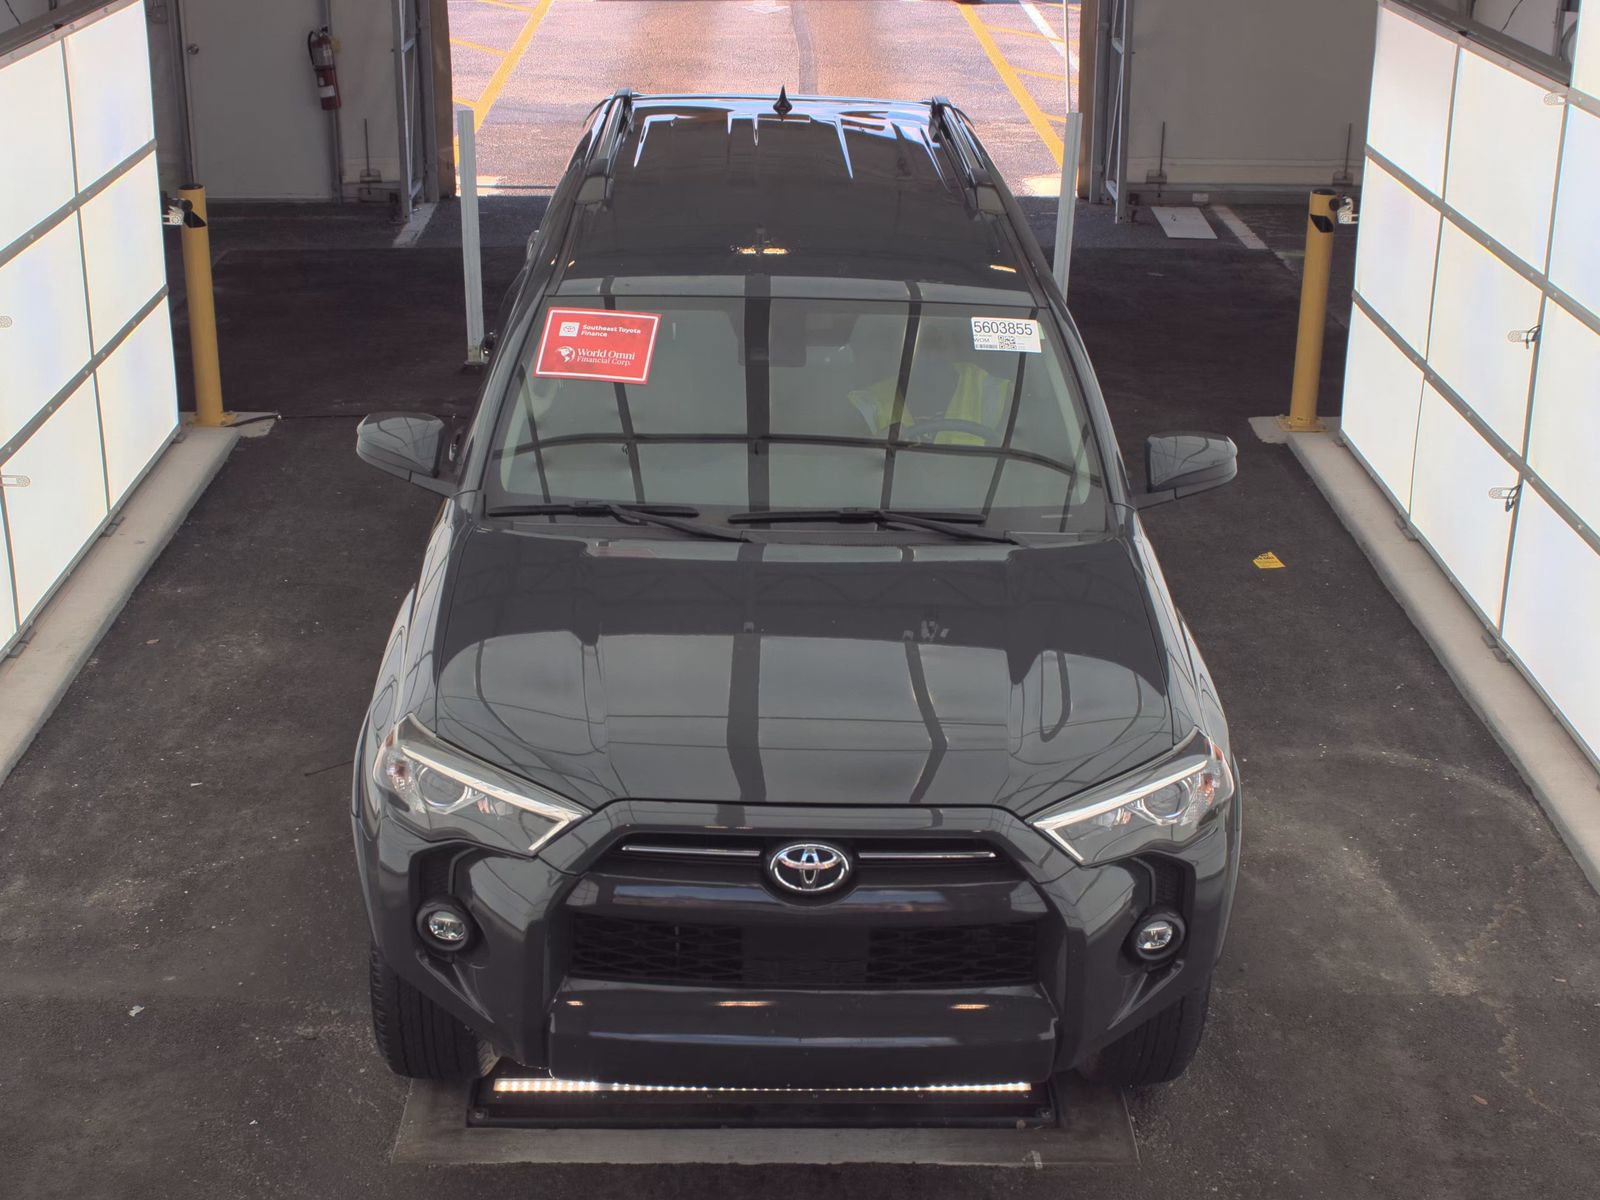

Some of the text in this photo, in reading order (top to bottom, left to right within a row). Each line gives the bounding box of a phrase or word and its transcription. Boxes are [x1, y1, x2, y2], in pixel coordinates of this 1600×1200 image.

[582, 324, 641, 334] Southeast Toyota
[974, 321, 1033, 336] 5603855
[577, 348, 636, 360] World Omni
[577, 355, 631, 366] Financial Corp.
